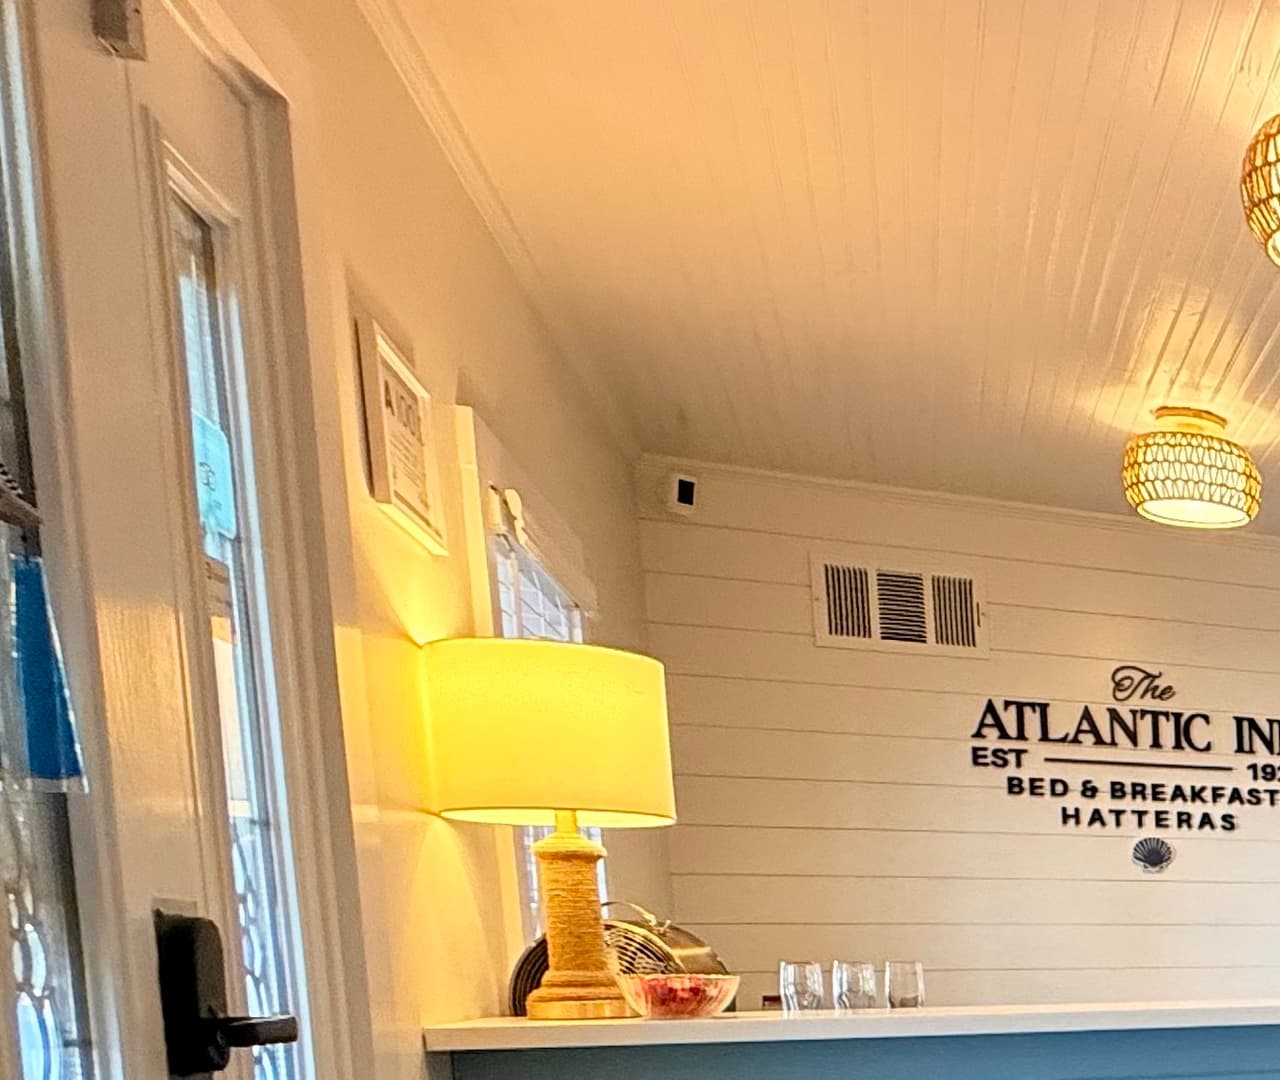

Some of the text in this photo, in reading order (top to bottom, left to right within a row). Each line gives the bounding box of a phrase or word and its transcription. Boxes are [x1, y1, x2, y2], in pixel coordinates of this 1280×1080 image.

[1111, 665, 1176, 701] The
[971, 698, 1212, 752] ATLANTIC
[971, 746, 1029, 768] EST
[1007, 776, 1280, 806] BED & BREAKFAST
[1061, 806, 1236, 831] HATTERAS
